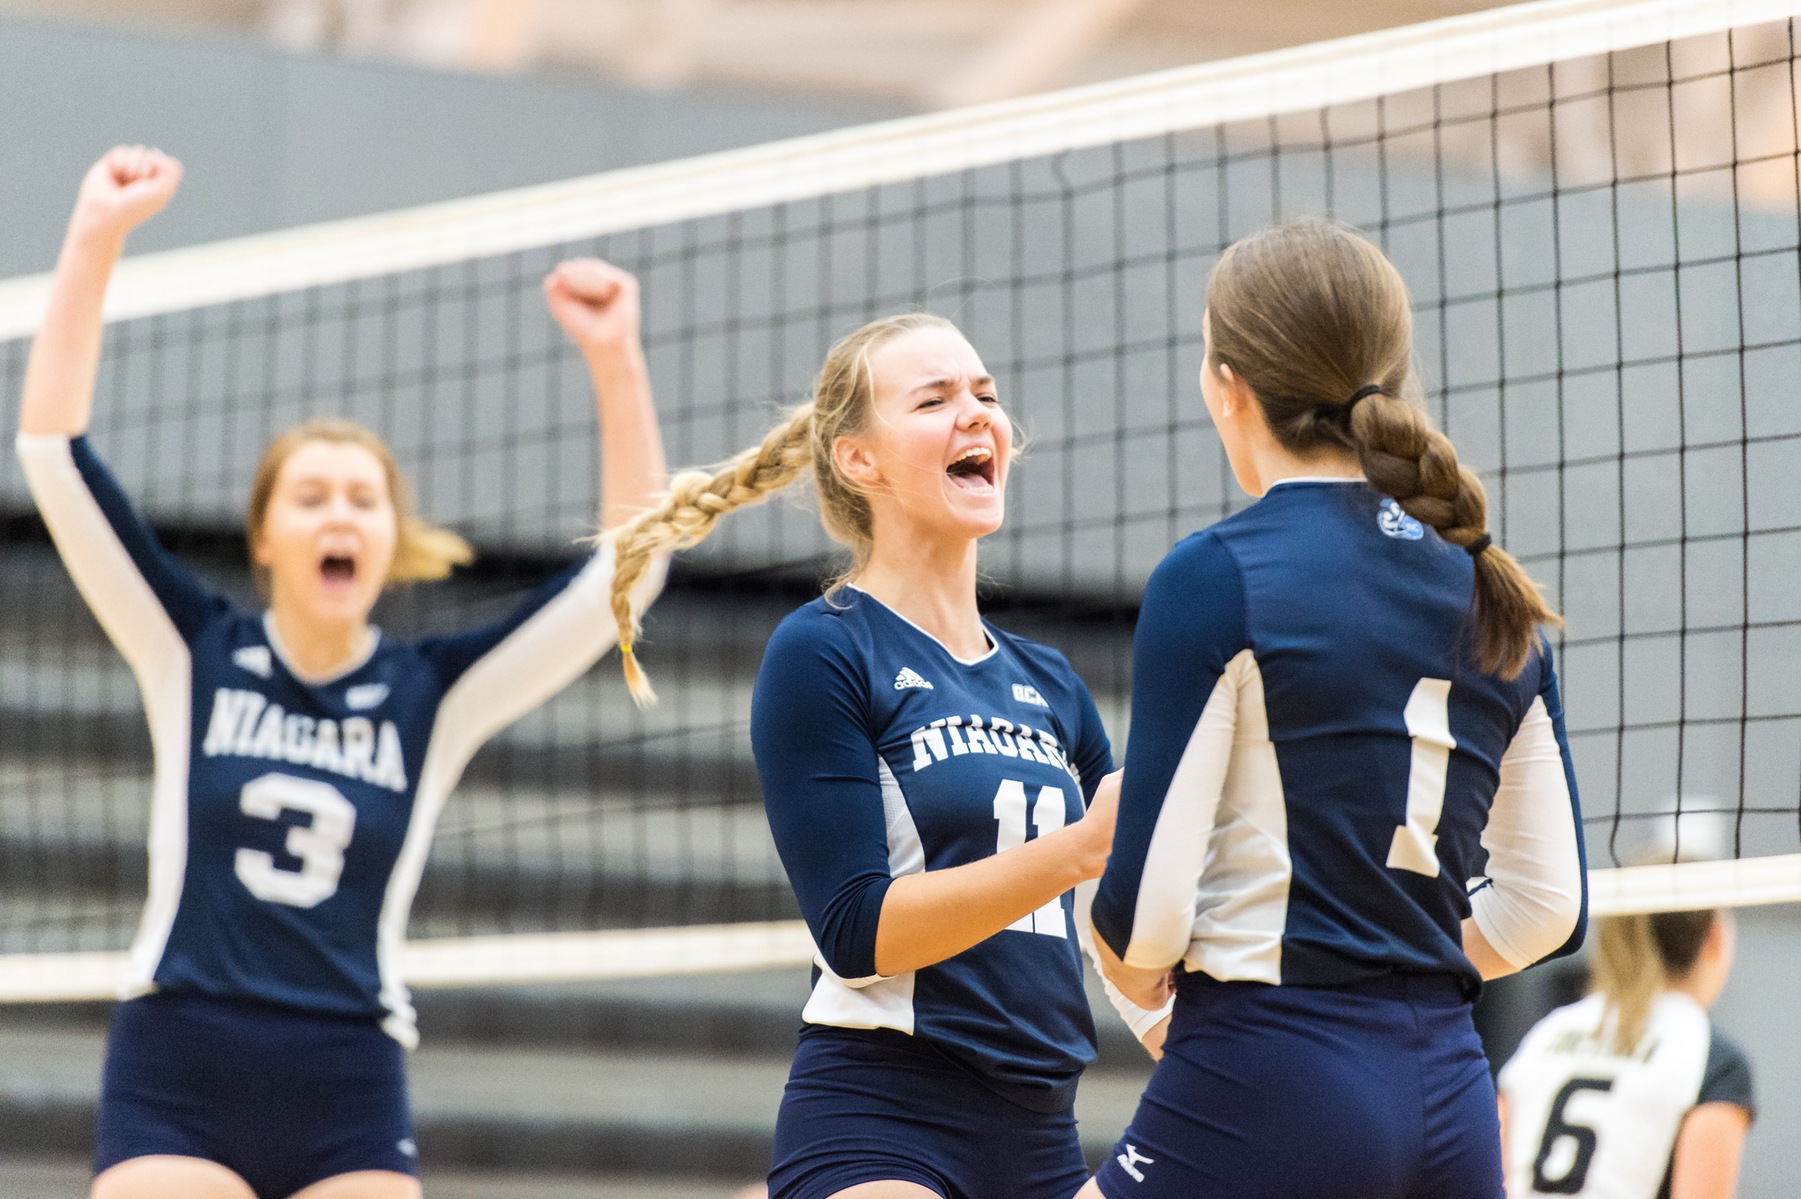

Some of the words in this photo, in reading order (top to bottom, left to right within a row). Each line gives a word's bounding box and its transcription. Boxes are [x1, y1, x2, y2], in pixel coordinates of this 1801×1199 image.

[203, 687, 409, 793] NIAGARA
[911, 714, 1067, 772] NIAGAR
[1386, 677, 1457, 878] 1
[234, 771, 357, 909] 3
[993, 778, 1067, 939] 11
[1532, 1075, 1615, 1195] 6
